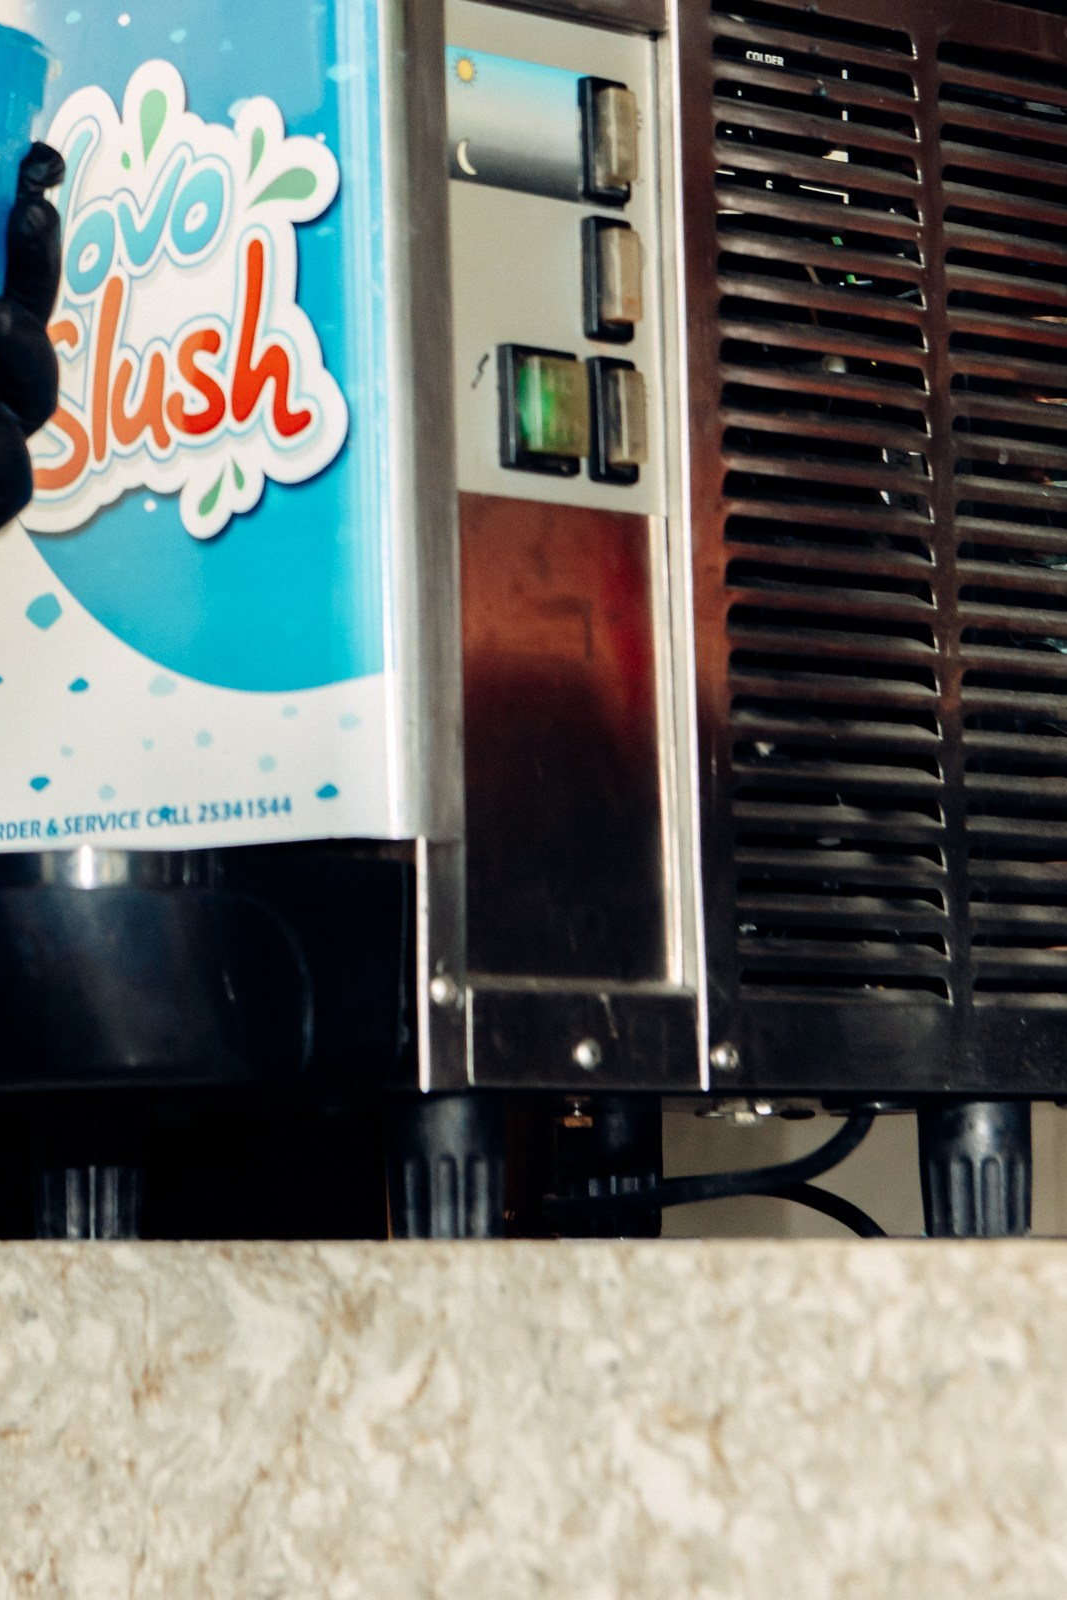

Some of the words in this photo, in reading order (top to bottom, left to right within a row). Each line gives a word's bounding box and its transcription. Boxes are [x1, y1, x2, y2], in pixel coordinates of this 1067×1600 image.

[745, 50, 784, 67] COLDER
[46, 816, 58, 836] &
[63, 808, 140, 835] SERVICE
